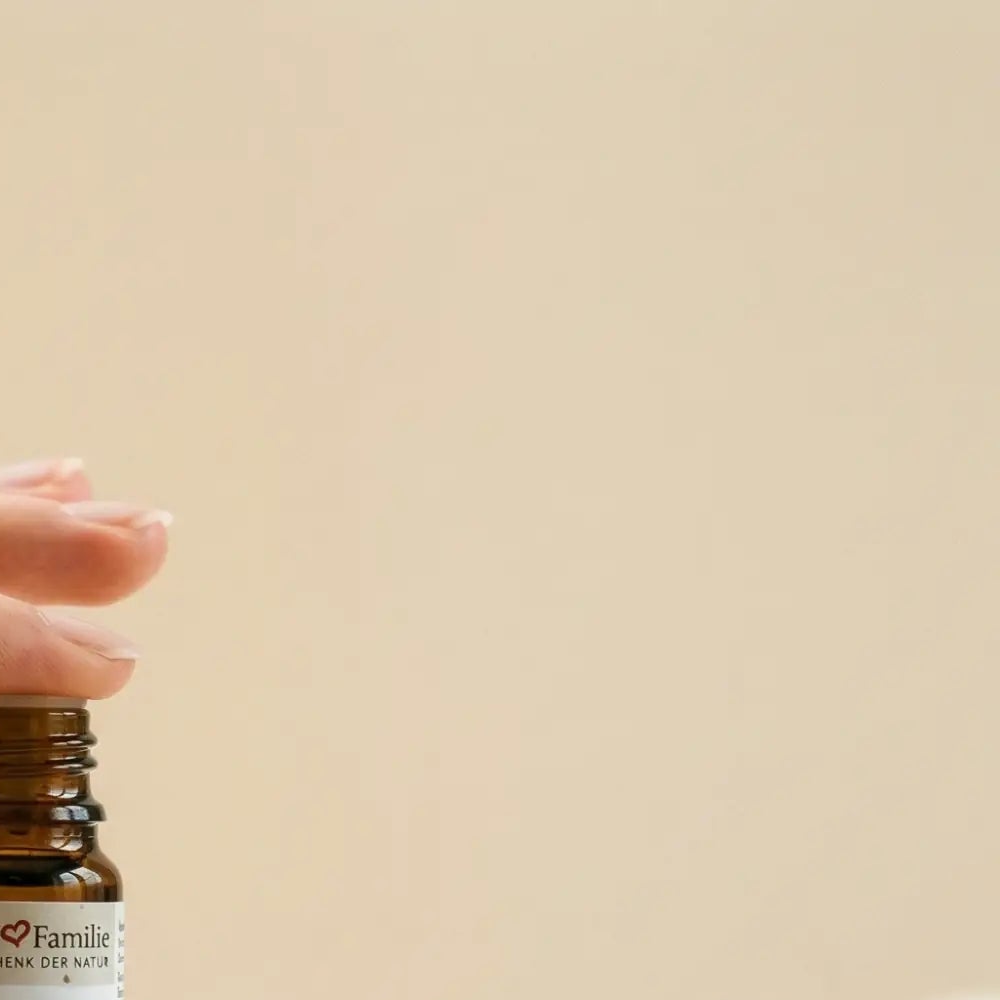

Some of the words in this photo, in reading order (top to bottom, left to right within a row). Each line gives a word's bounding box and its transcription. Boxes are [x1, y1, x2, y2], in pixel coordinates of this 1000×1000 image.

[33, 924, 110, 949] Familie
[41, 956, 68, 969] DER
[74, 956, 109, 969] NATUR
